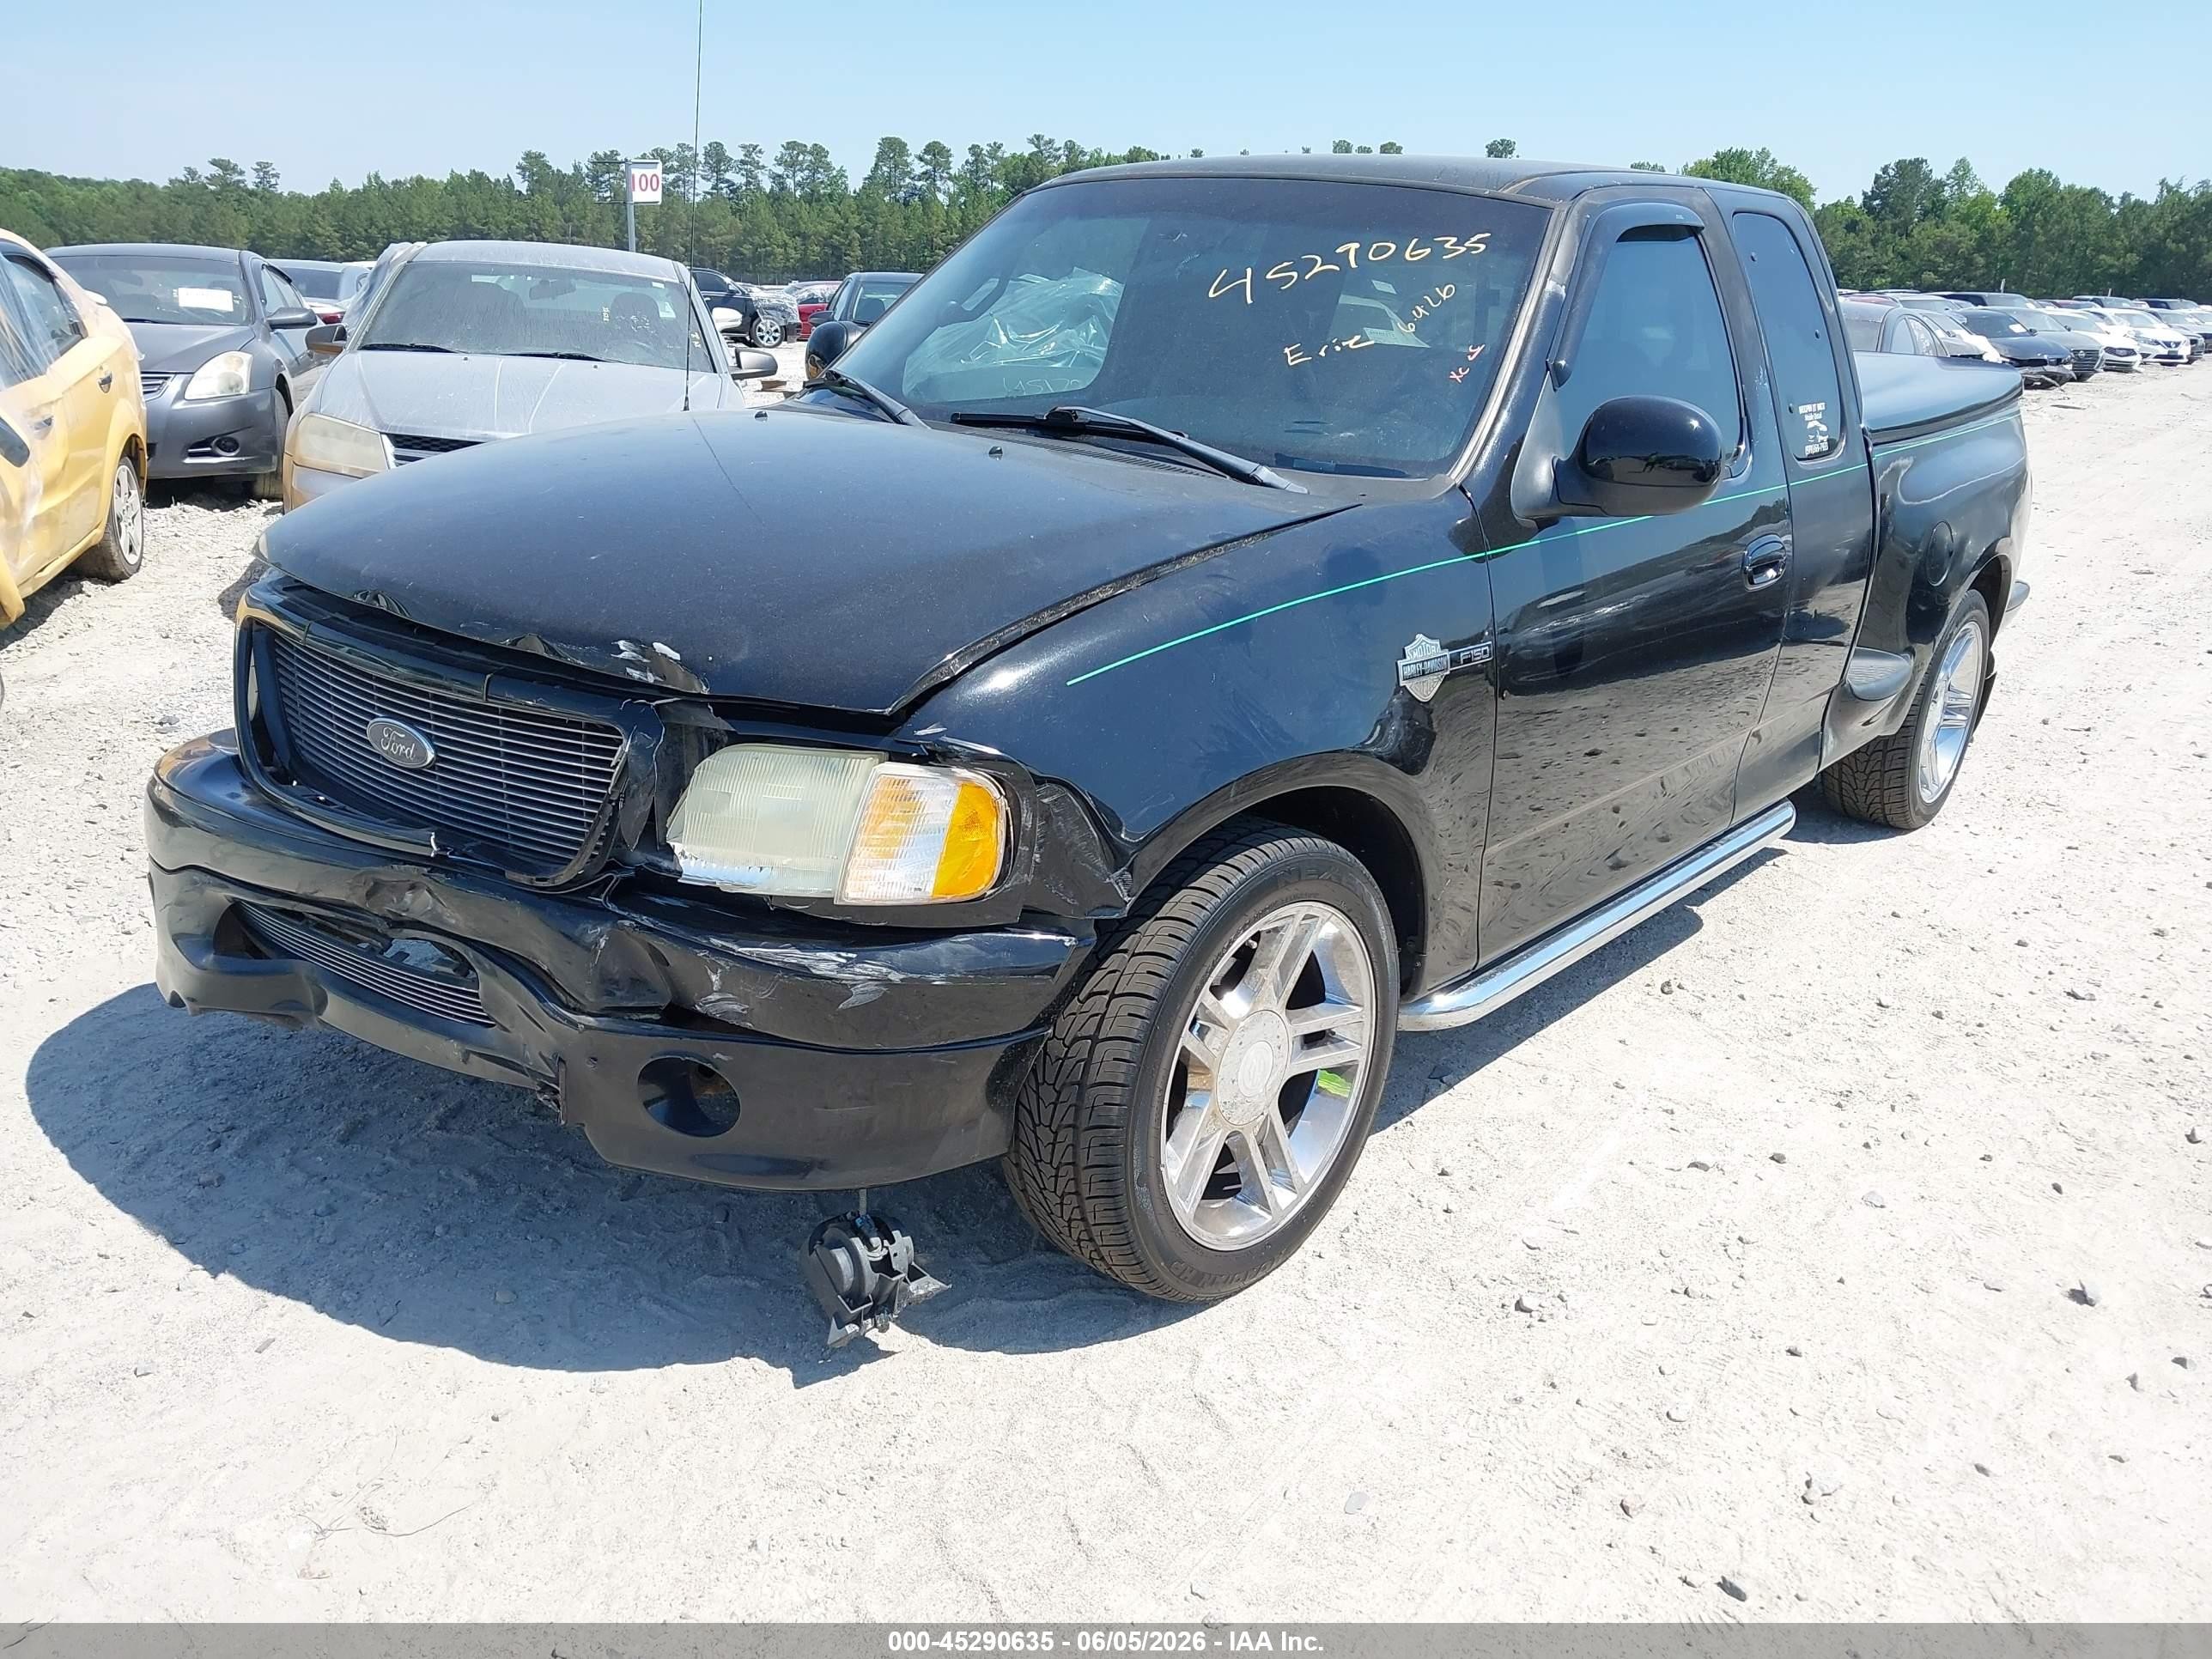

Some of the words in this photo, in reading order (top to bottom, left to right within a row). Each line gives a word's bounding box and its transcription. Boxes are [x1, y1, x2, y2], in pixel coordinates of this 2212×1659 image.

[631, 173, 659, 192] 100
[1208, 233, 1492, 304] 45290635
[1284, 334, 1375, 366] Eric
[380, 726, 416, 760] Ford
